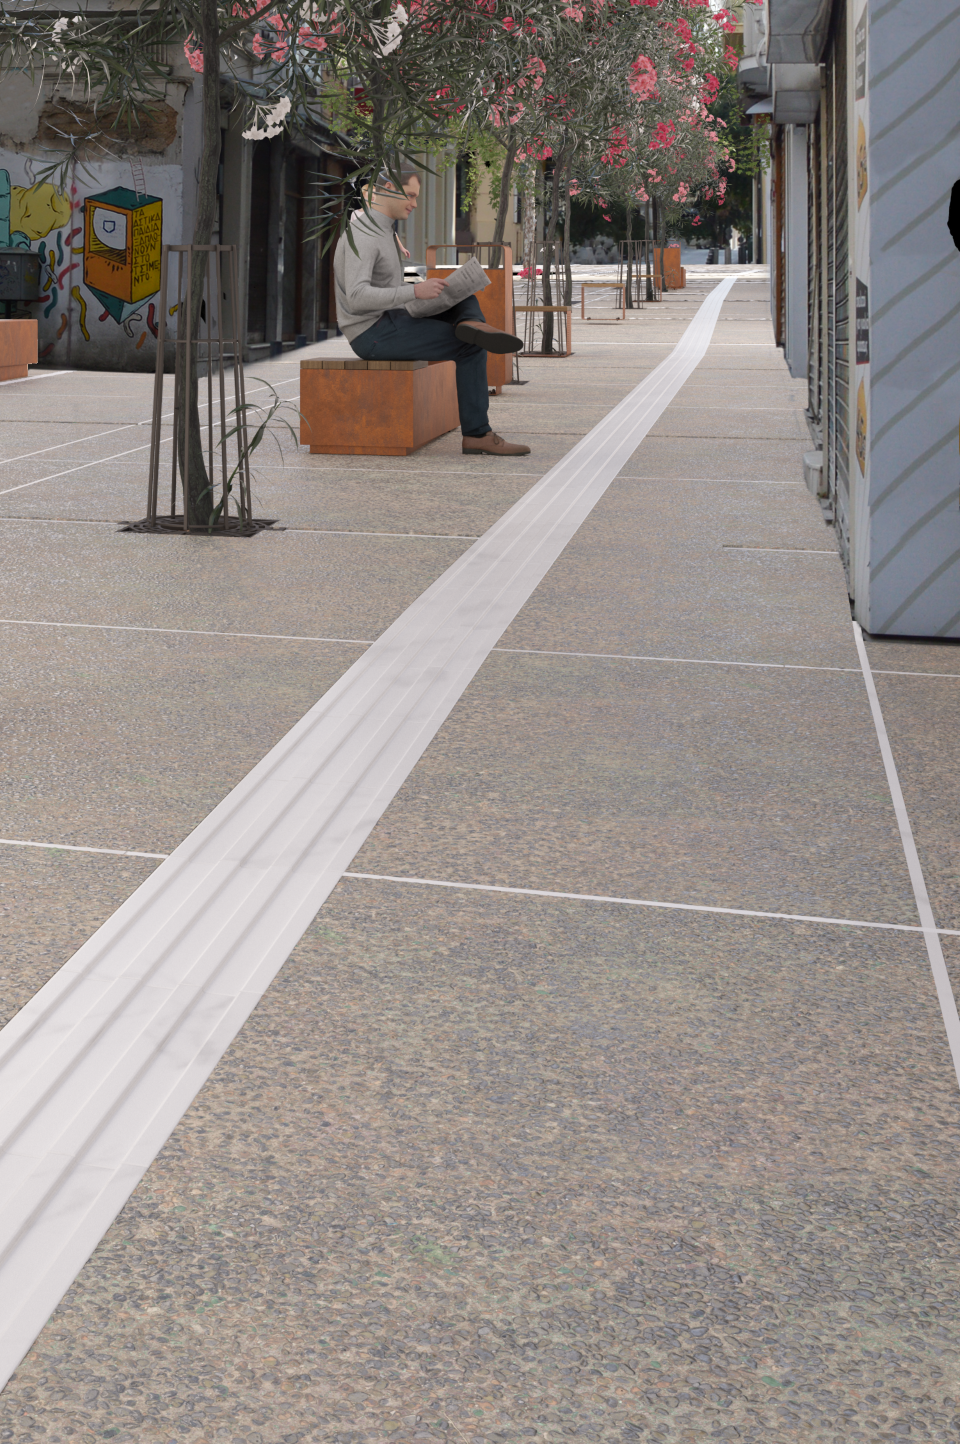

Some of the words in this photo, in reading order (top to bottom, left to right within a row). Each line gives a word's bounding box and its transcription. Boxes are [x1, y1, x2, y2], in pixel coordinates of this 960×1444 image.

[133, 212, 161, 228] ΑΣΤΙΚΑ
[134, 208, 145, 219] ΤΑ
[133, 222, 160, 237] ΠΑΙΔΙΑ
[134, 242, 157, 256] ΝΟΥΝ
[133, 253, 151, 265] ΣΤΟ
